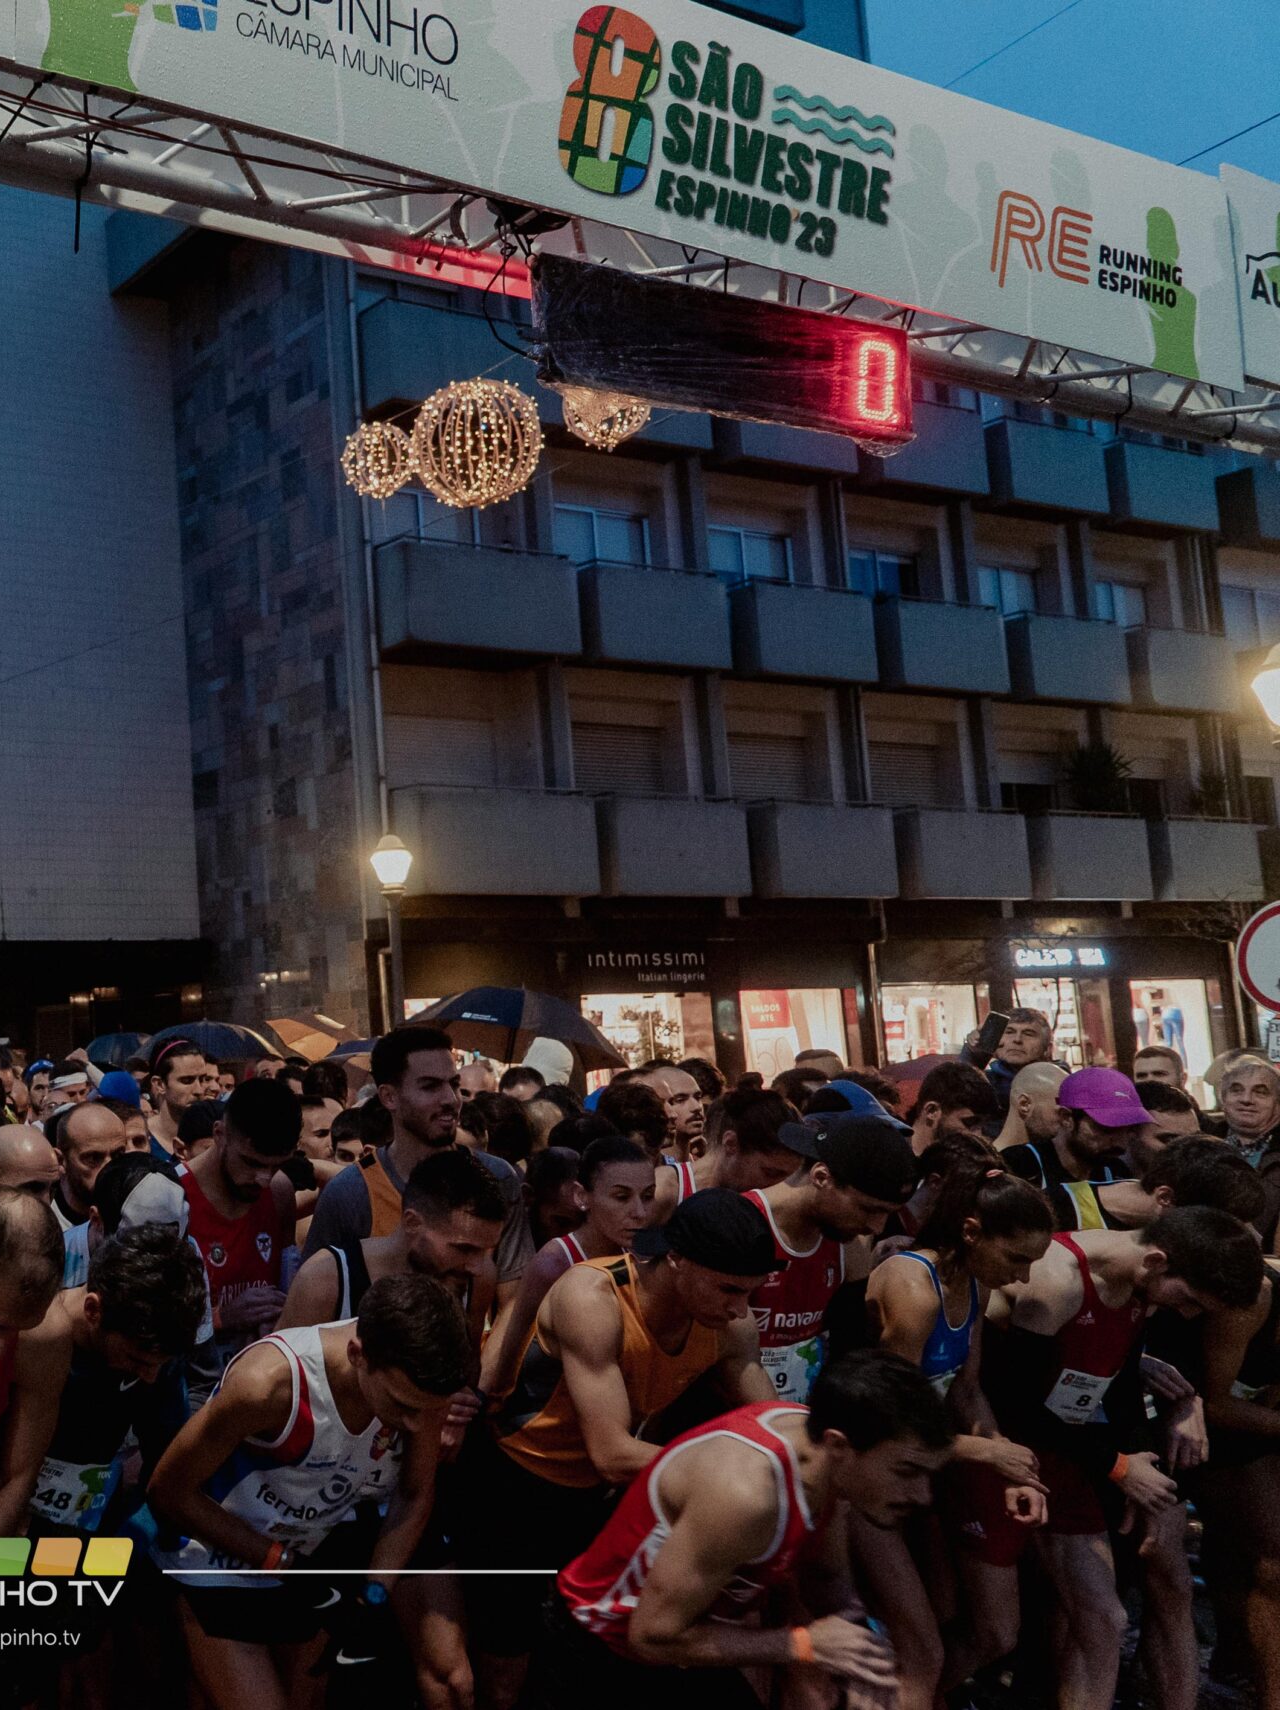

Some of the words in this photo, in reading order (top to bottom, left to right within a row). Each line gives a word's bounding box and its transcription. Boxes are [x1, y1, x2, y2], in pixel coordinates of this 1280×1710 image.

[236, 11, 337, 63] CÂMARA
[343, 44, 459, 101] MUNICIPAL
[246, 0, 458, 65] INHO
[668, 40, 763, 120] SÃO
[662, 102, 893, 226] SILVESTRE
[990, 190, 1093, 288] RE
[1098, 244, 1183, 286] RUNNING
[1097, 269, 1176, 308] ESPINHO
[587, 950, 706, 967] intimissimi
[637, 973, 668, 982] Italian
[670, 971, 706, 984] lingerie
[776, 1372, 787, 1389] 9
[1076, 1394, 1091, 1407] 8
